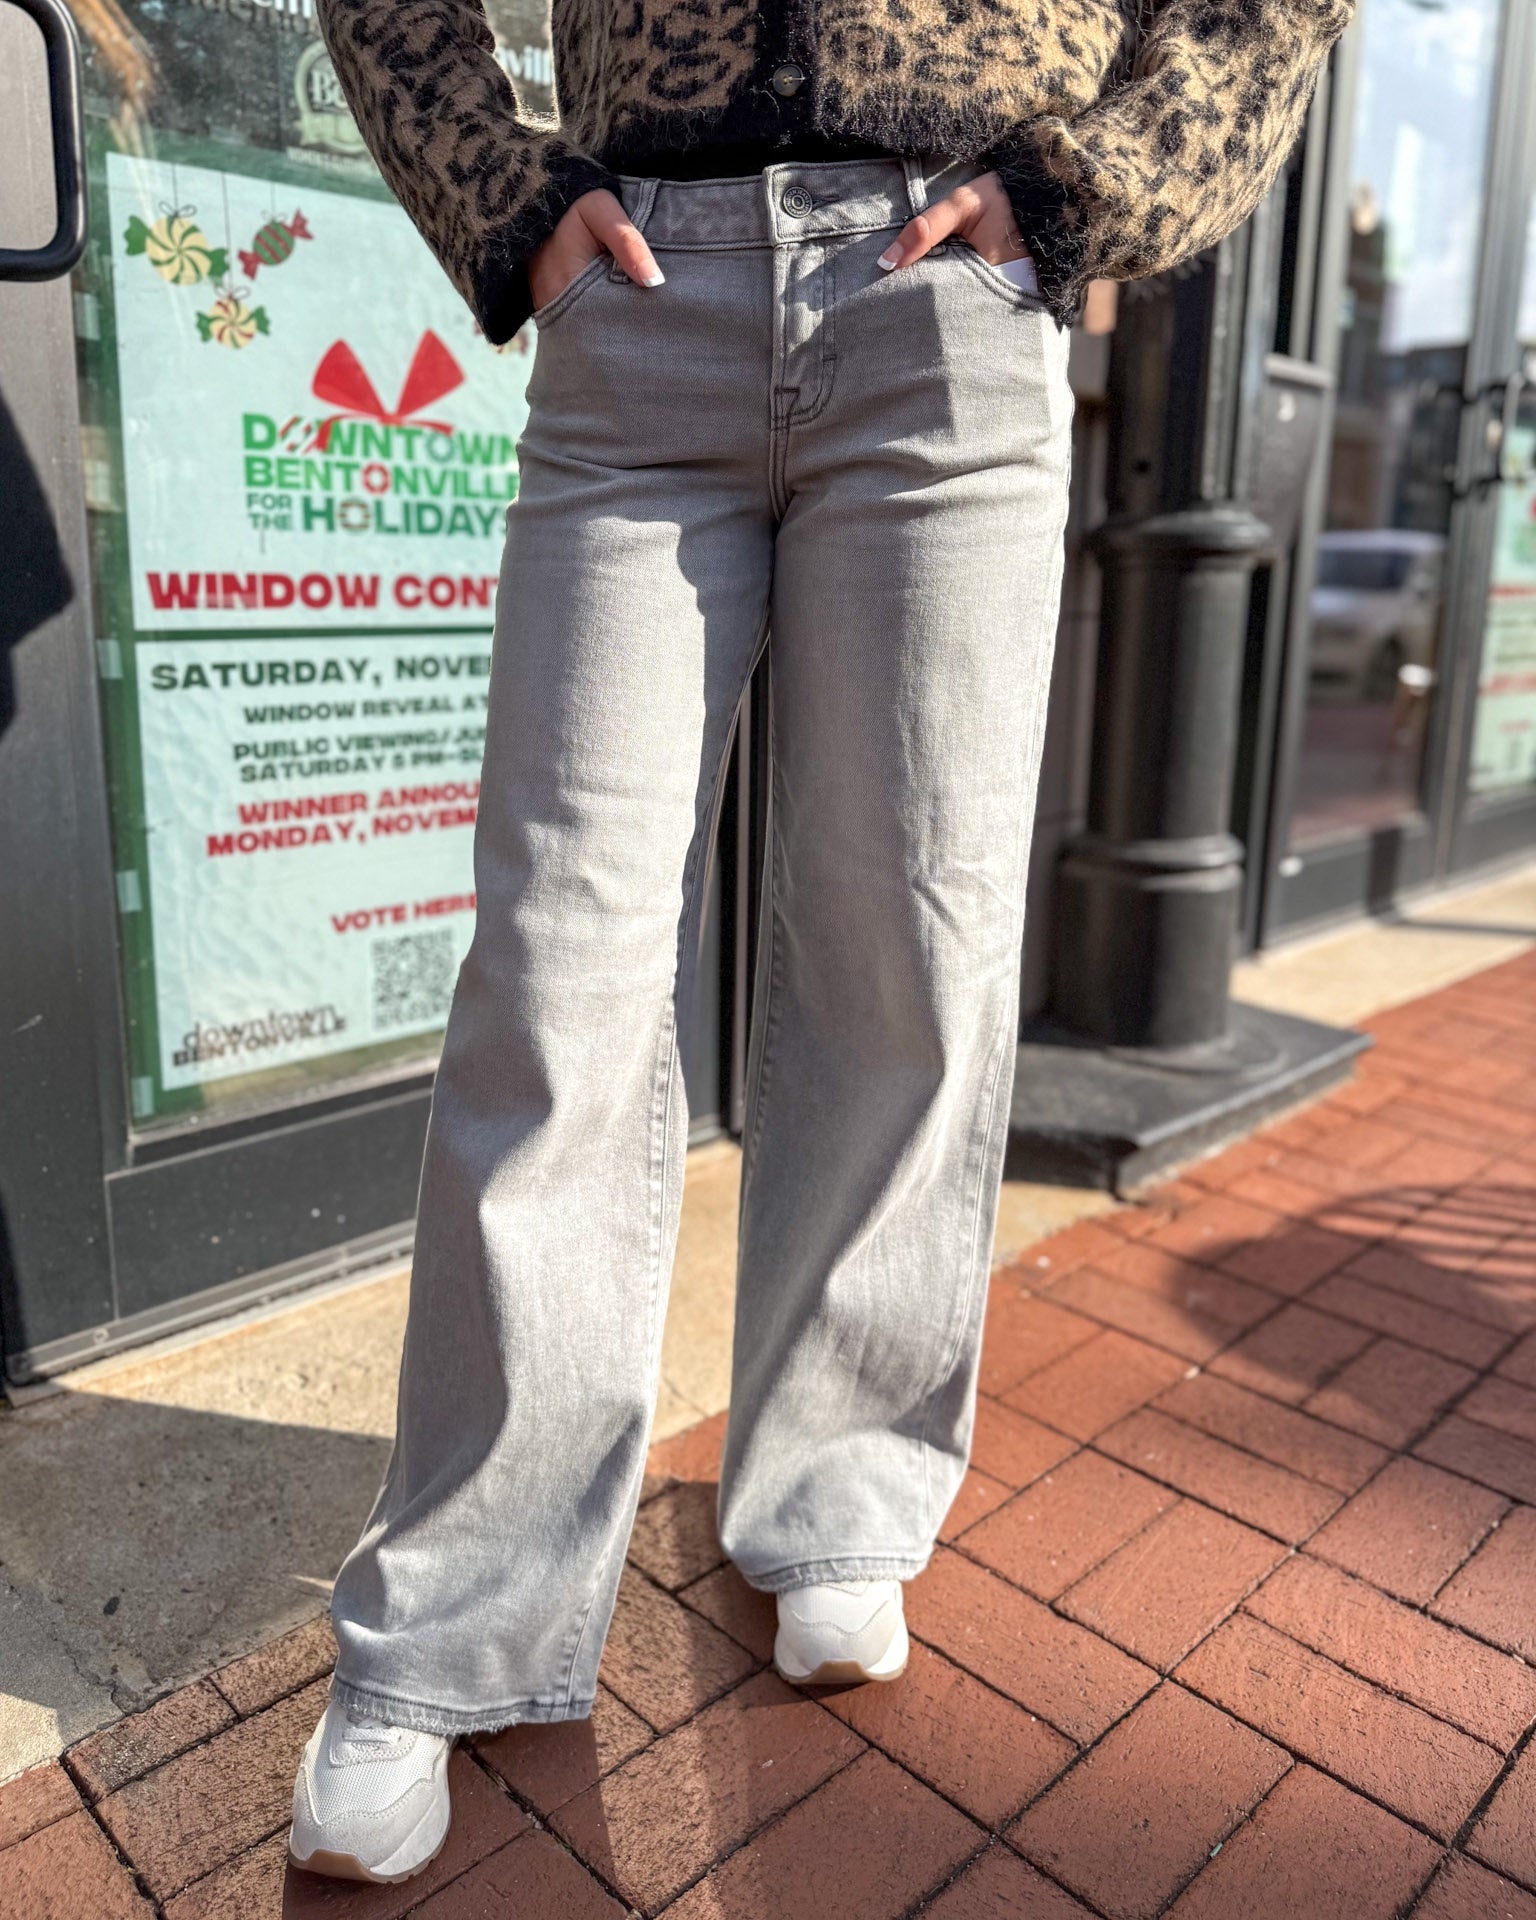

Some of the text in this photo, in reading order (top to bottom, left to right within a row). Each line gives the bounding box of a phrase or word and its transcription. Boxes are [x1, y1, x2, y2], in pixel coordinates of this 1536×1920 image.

[246, 492, 293, 512] FOR
[302, 495, 507, 538] HOLIDAY
[248, 511, 294, 532] THE
[146, 572, 498, 610] WINDOW CON
[150, 653, 491, 691] SATURDAY, NOVE
[243, 701, 356, 724] WINDOW
[362, 694, 454, 717] REVEAL
[232, 736, 330, 762] PUBLIC
[240, 755, 385, 784] SATURDAY
[238, 790, 369, 826] WINNER
[206, 818, 367, 858] MONDAY,
[330, 902, 406, 934] VOTE
[183, 1004, 335, 1050] downtown
